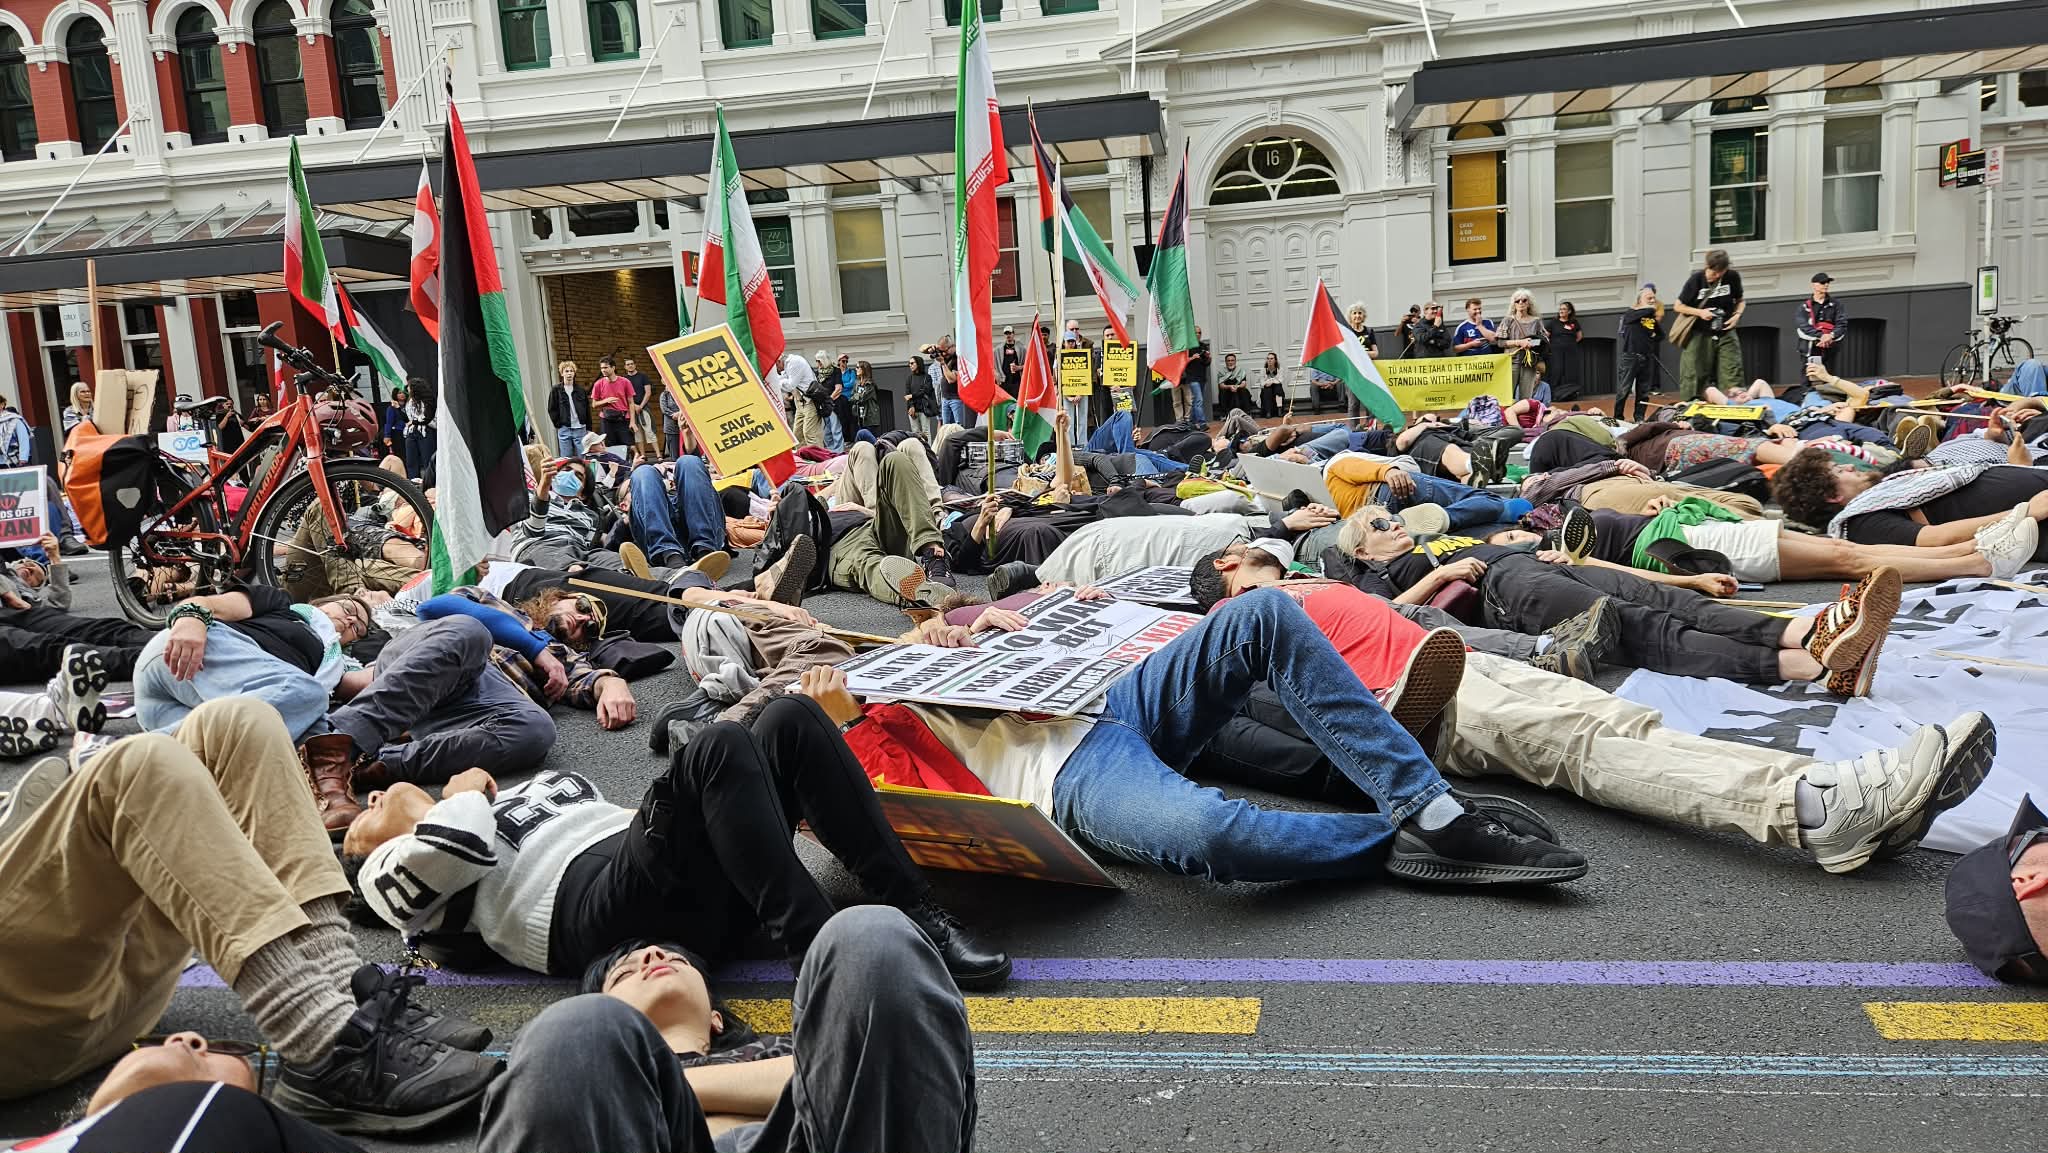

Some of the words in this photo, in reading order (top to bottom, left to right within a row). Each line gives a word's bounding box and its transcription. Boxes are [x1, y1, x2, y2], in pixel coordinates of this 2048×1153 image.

[1266, 150, 1280, 166] 16
[1467, 329, 1475, 337] 12
[678, 351, 730, 382] STOP
[1389, 376, 1429, 387] STANDING
[1430, 375, 1451, 385] WITH
[1453, 372, 1494, 384] HUMANITY
[1399, 366, 1412, 374] ANA
[1418, 365, 1427, 374] TE
[1429, 364, 1446, 373] TAHA
[1447, 364, 1453, 372] O
[1454, 363, 1463, 372] TE
[1465, 361, 1495, 371] TANGATA
[682, 367, 742, 399] WARS
[714, 421, 775, 453] LEBANON
[719, 413, 755, 436] SAVE
[15, 508, 33, 517] OFF
[1027, 598, 1118, 632] WAR
[1135, 614, 1200, 643] WAR
[1050, 618, 1114, 648] BUT
[856, 666, 905, 680] END
[886, 652, 934, 665] THE
[880, 649, 989, 695] OCCUPATION
[957, 669, 1019, 692] PEACE
[999, 656, 1044, 671] AND
[1000, 656, 1091, 701] LIBERATION
